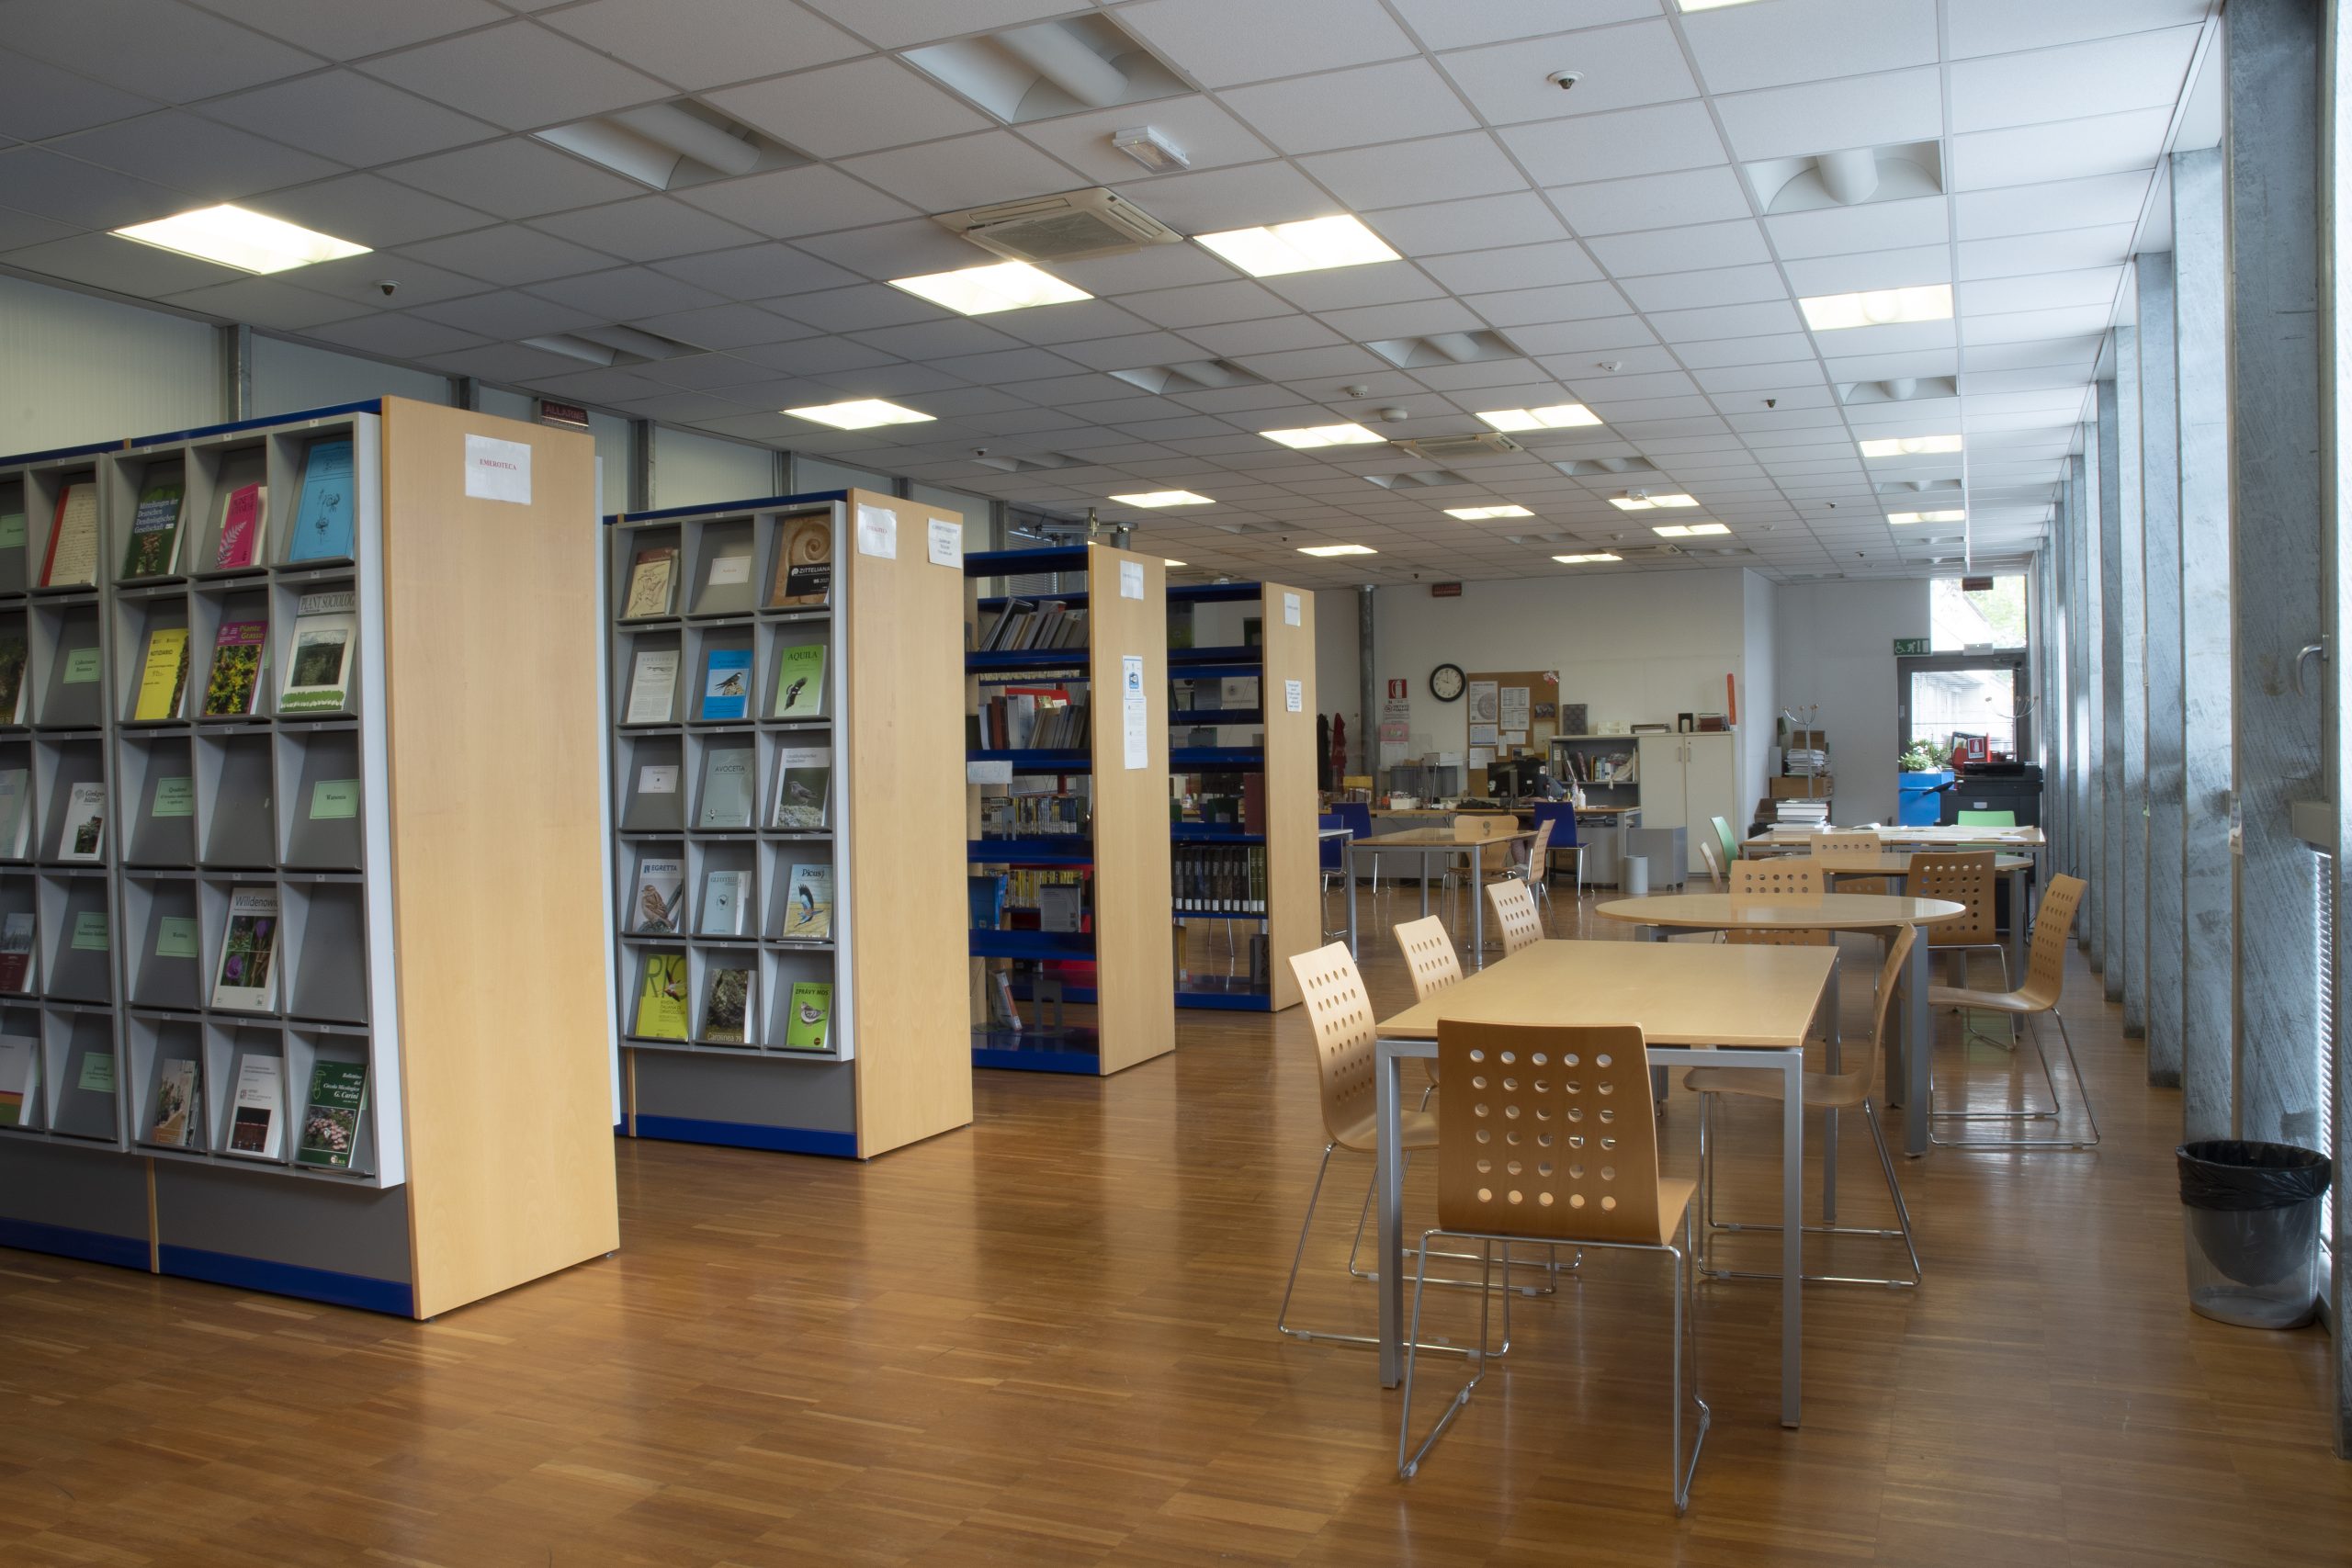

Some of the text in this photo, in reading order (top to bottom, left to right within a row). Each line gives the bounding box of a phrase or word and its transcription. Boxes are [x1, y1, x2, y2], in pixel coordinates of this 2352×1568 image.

[480, 458, 517, 471] EMEROTECA
[300, 596, 322, 610] PLANT
[787, 650, 818, 660] AQUILA
